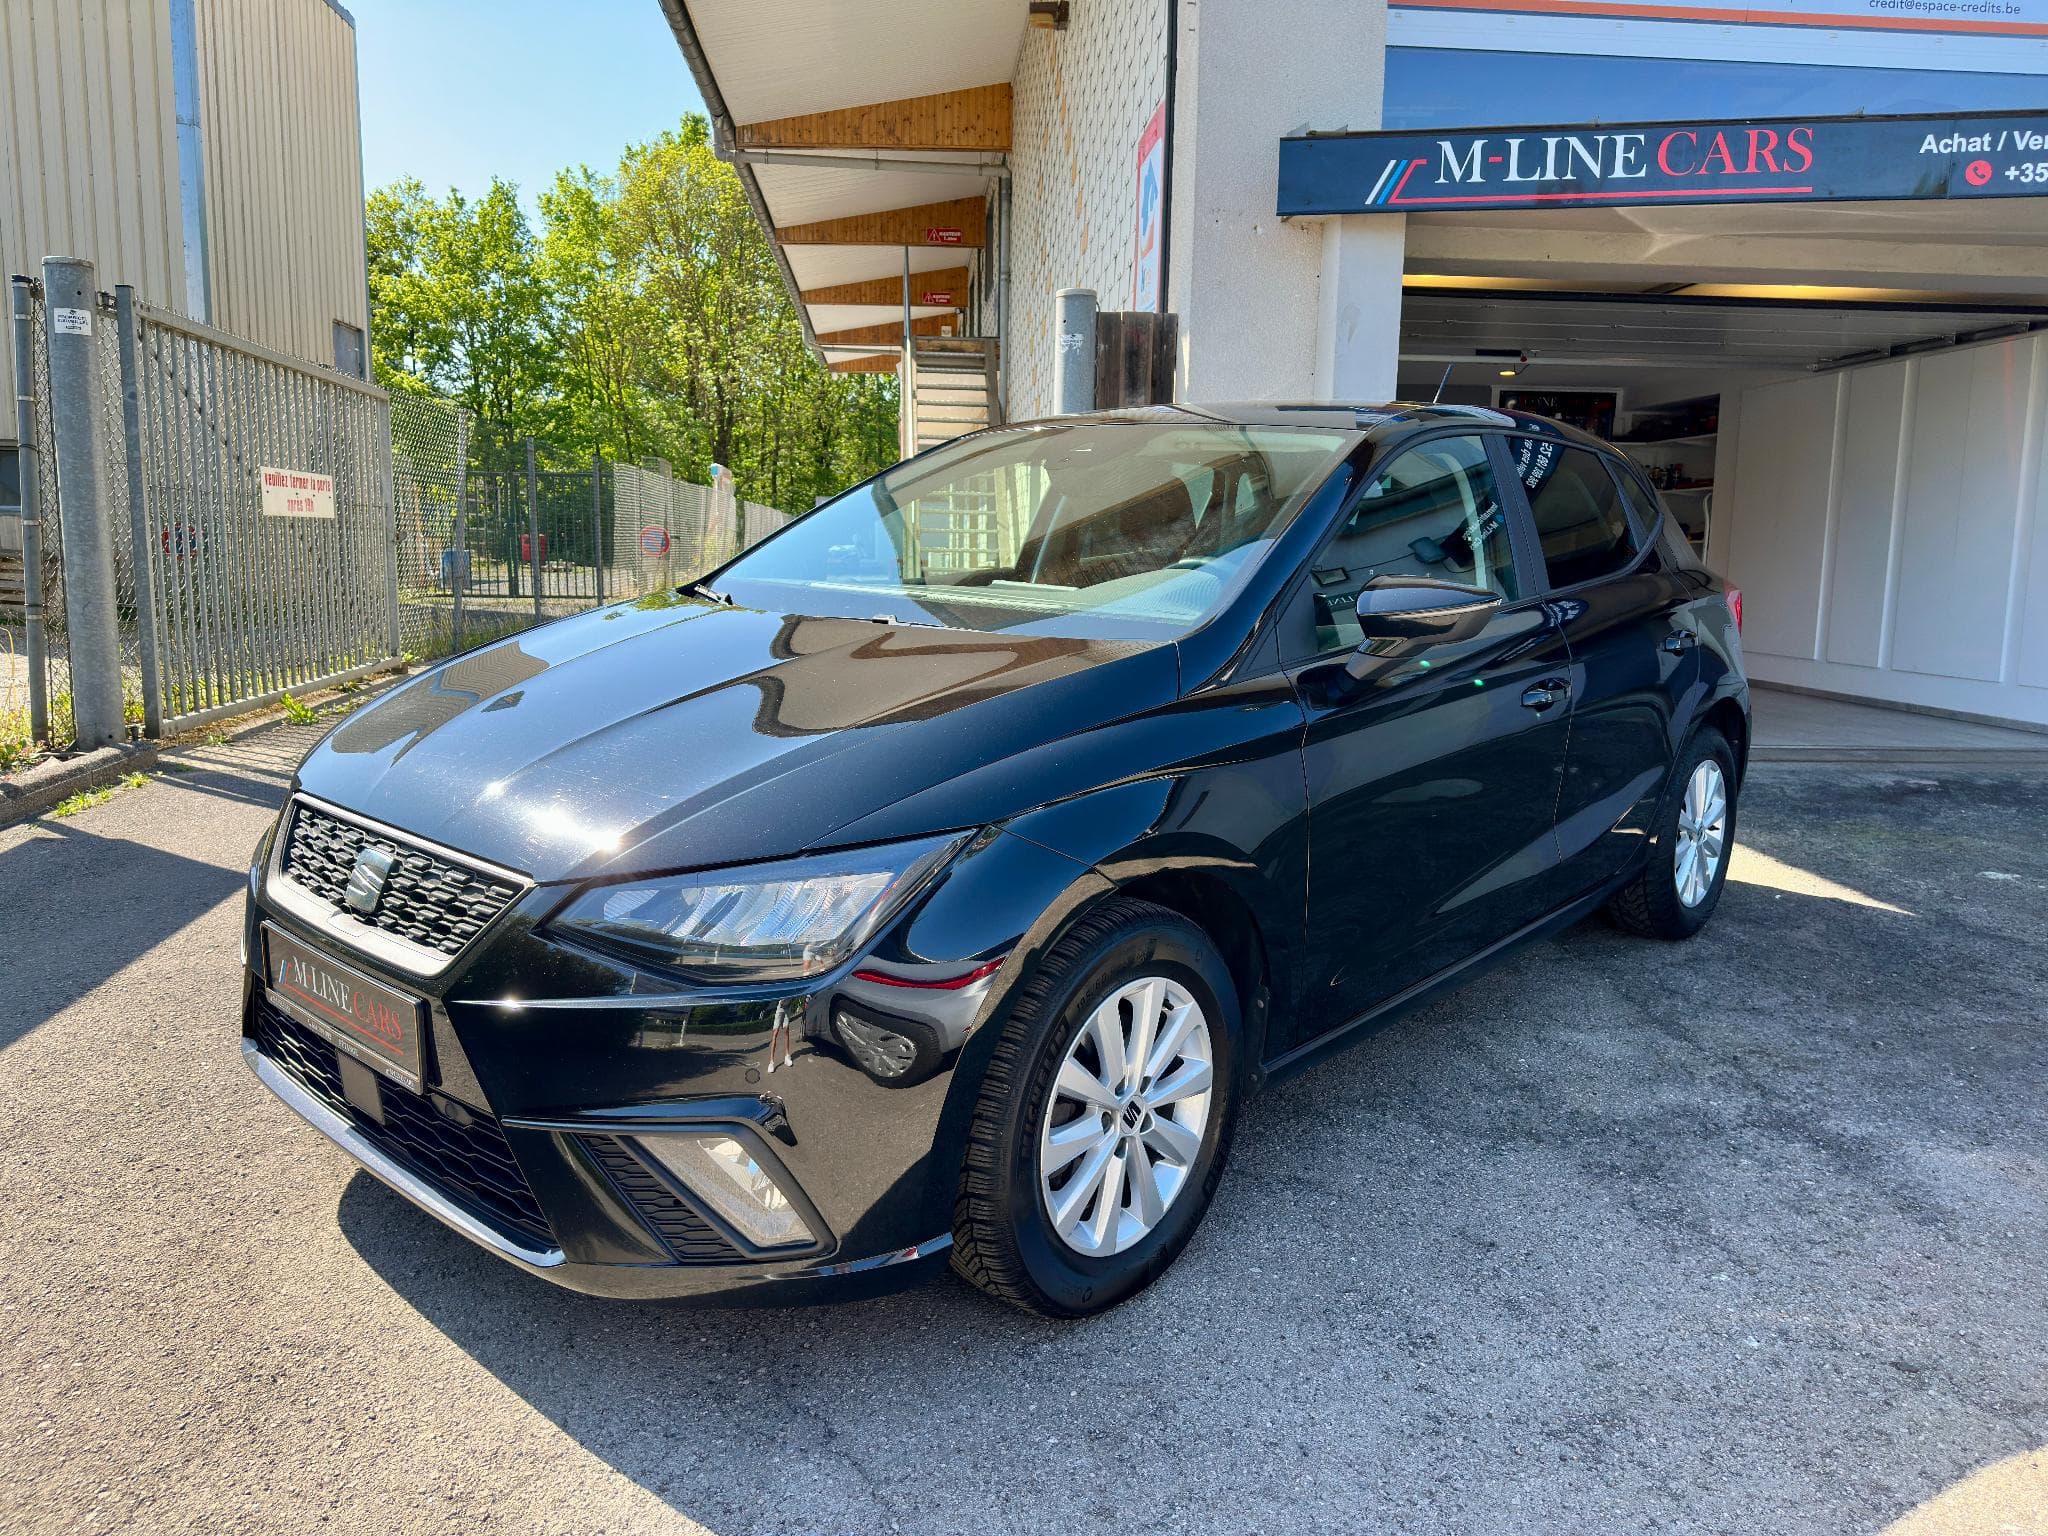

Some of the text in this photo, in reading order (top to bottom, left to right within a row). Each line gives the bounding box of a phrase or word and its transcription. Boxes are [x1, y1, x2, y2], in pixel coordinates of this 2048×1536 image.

[1869, 0, 2021, 14] credit@espace-credits.be
[1434, 127, 1813, 184] M-LINE CARS
[1919, 131, 1992, 154] Achat
[293, 956, 352, 1014] M-LINE
[353, 991, 403, 1041] CARS
